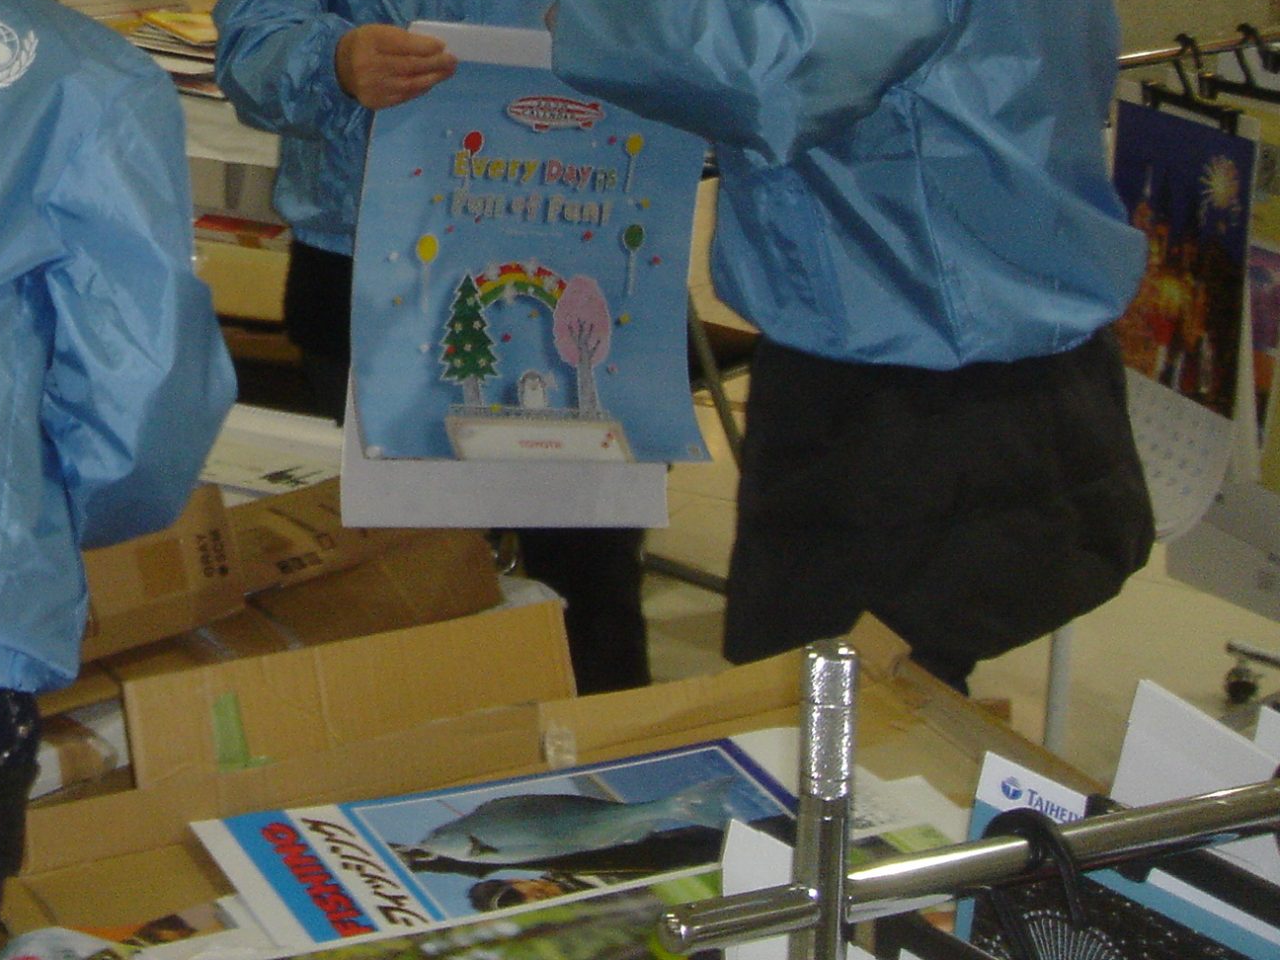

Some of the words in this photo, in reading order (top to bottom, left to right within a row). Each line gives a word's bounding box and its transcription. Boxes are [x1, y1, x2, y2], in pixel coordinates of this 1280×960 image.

[454, 150, 540, 184] Every
[546, 159, 593, 192] Day
[452, 188, 506, 218] Full
[511, 191, 542, 221] of
[547, 194, 612, 225] Fun!
